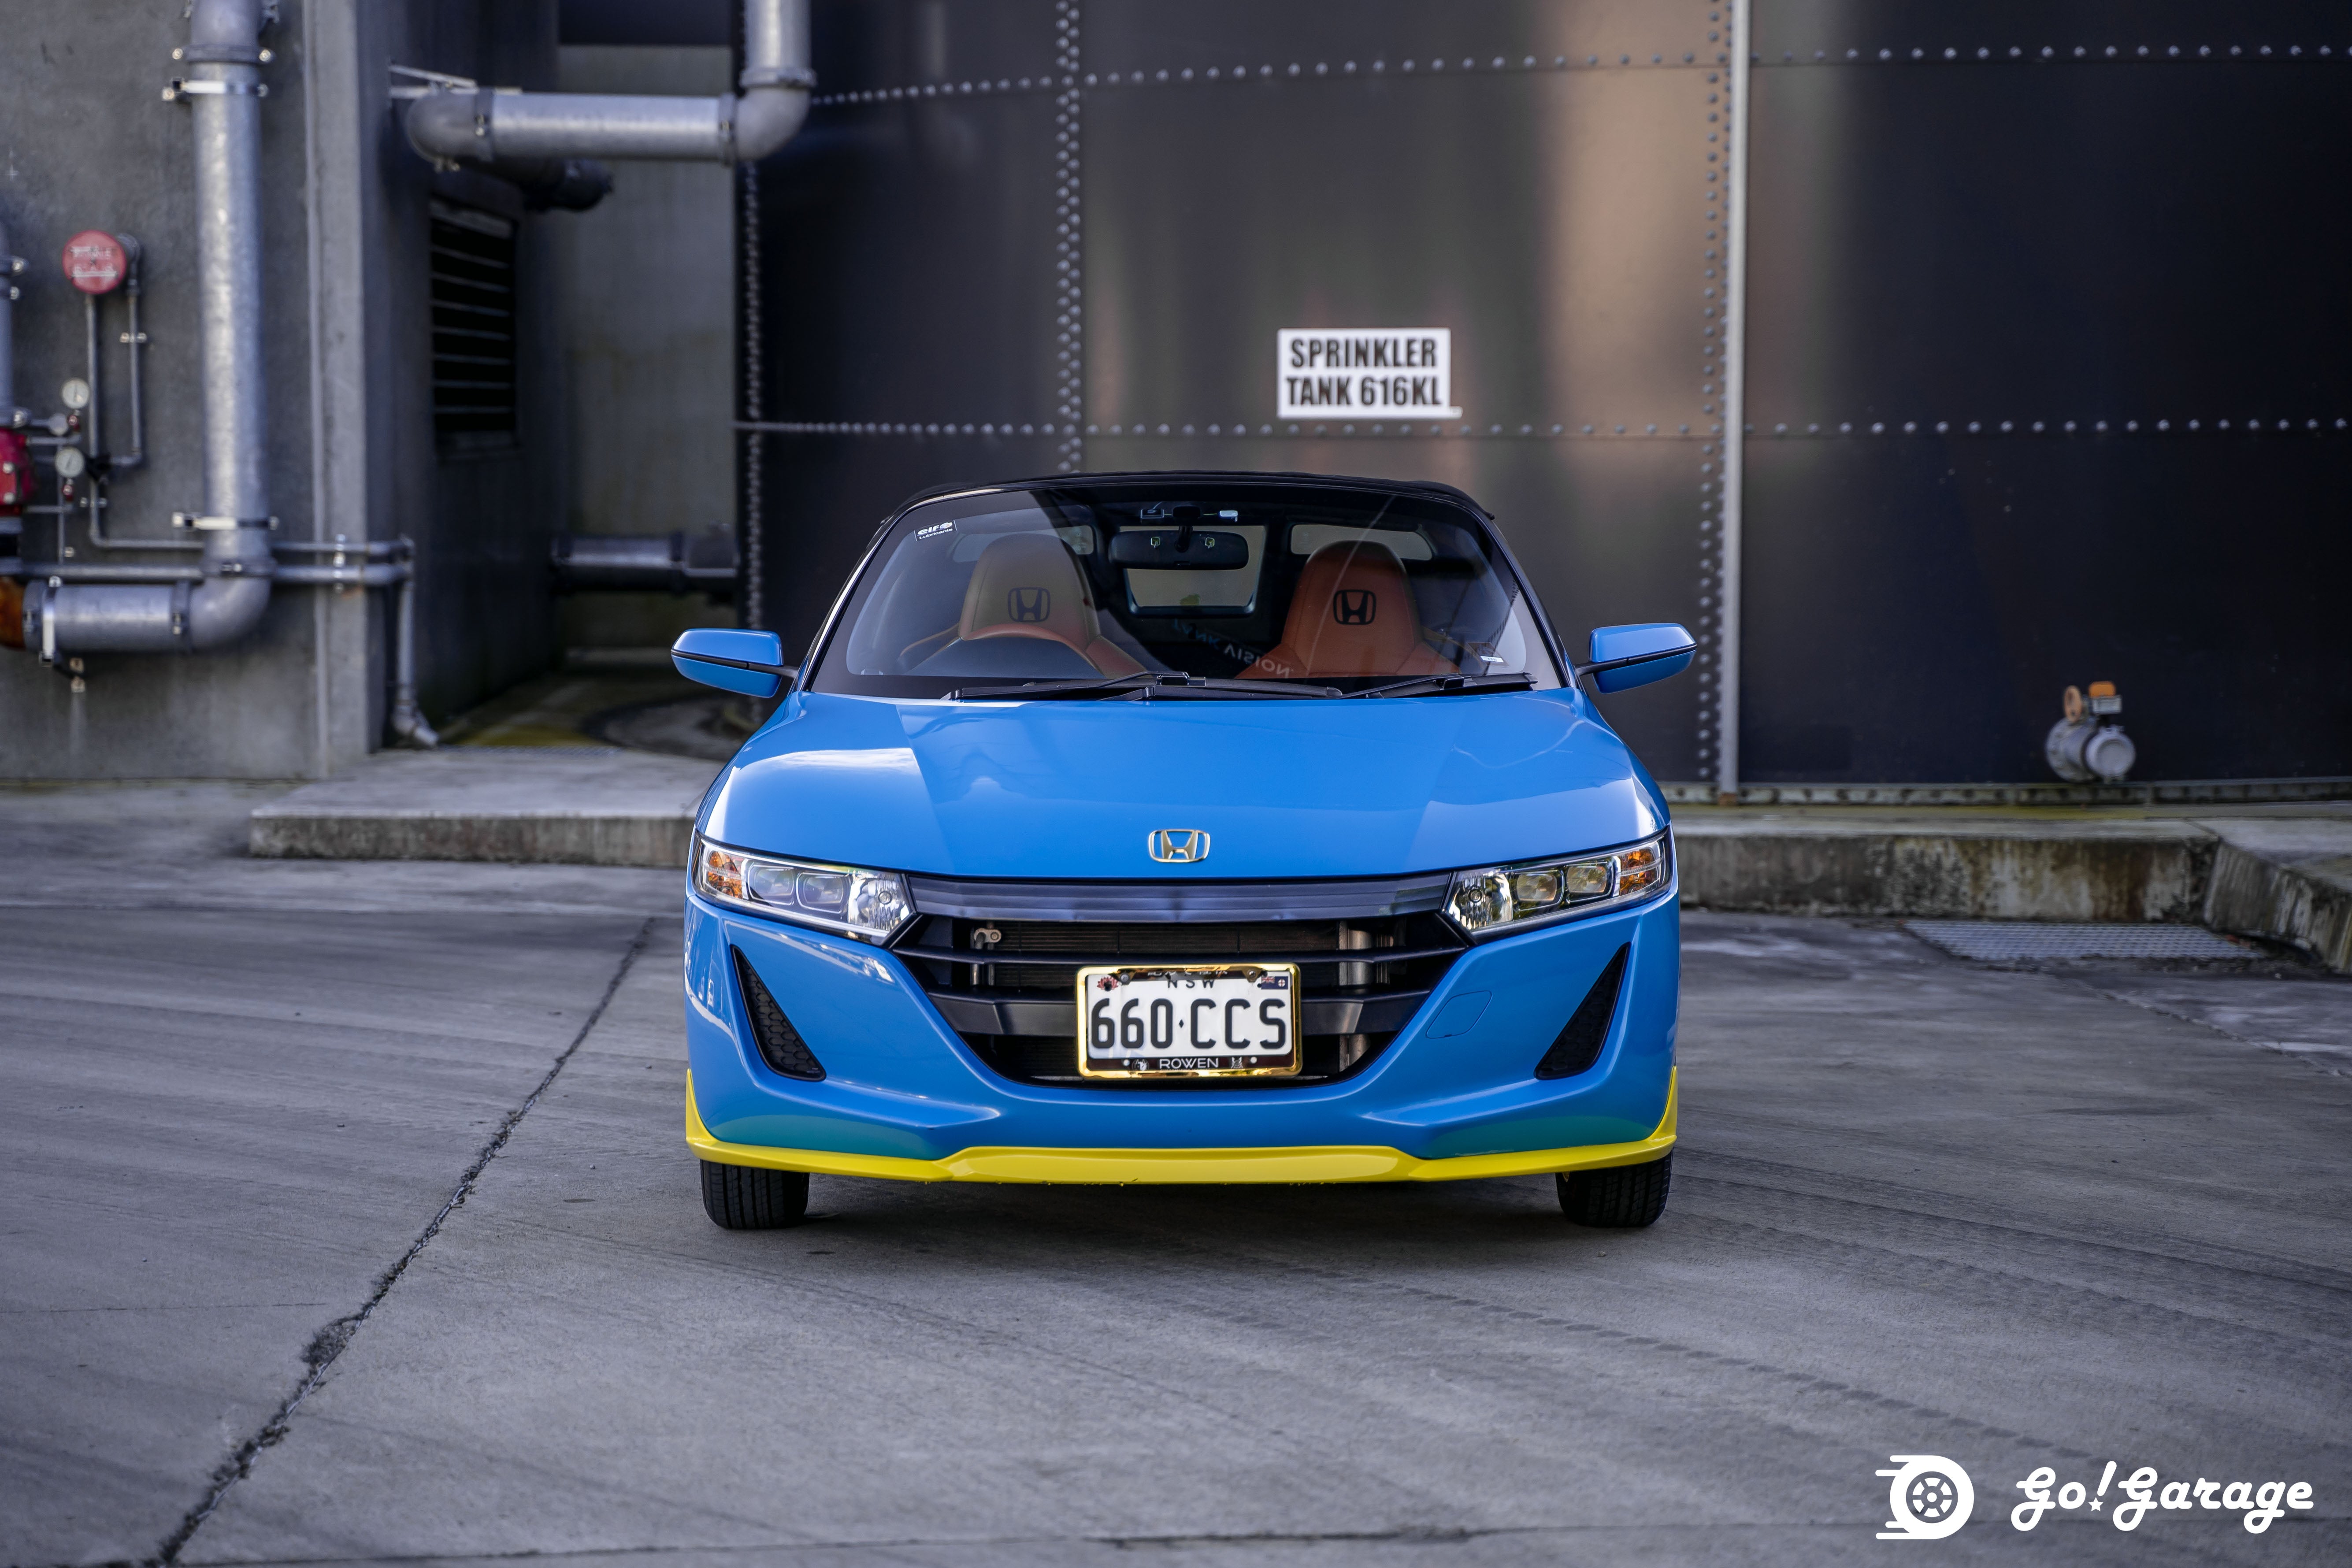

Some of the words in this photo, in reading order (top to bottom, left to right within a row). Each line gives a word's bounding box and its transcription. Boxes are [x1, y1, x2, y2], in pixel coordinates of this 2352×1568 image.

[1291, 338, 1436, 368] SPRINKLER
[1286, 376, 1353, 406] TANK
[1360, 376, 1441, 406] 616KL
[917, 525, 939, 535] elf
[1159, 1058, 1219, 1069] ROWEN
